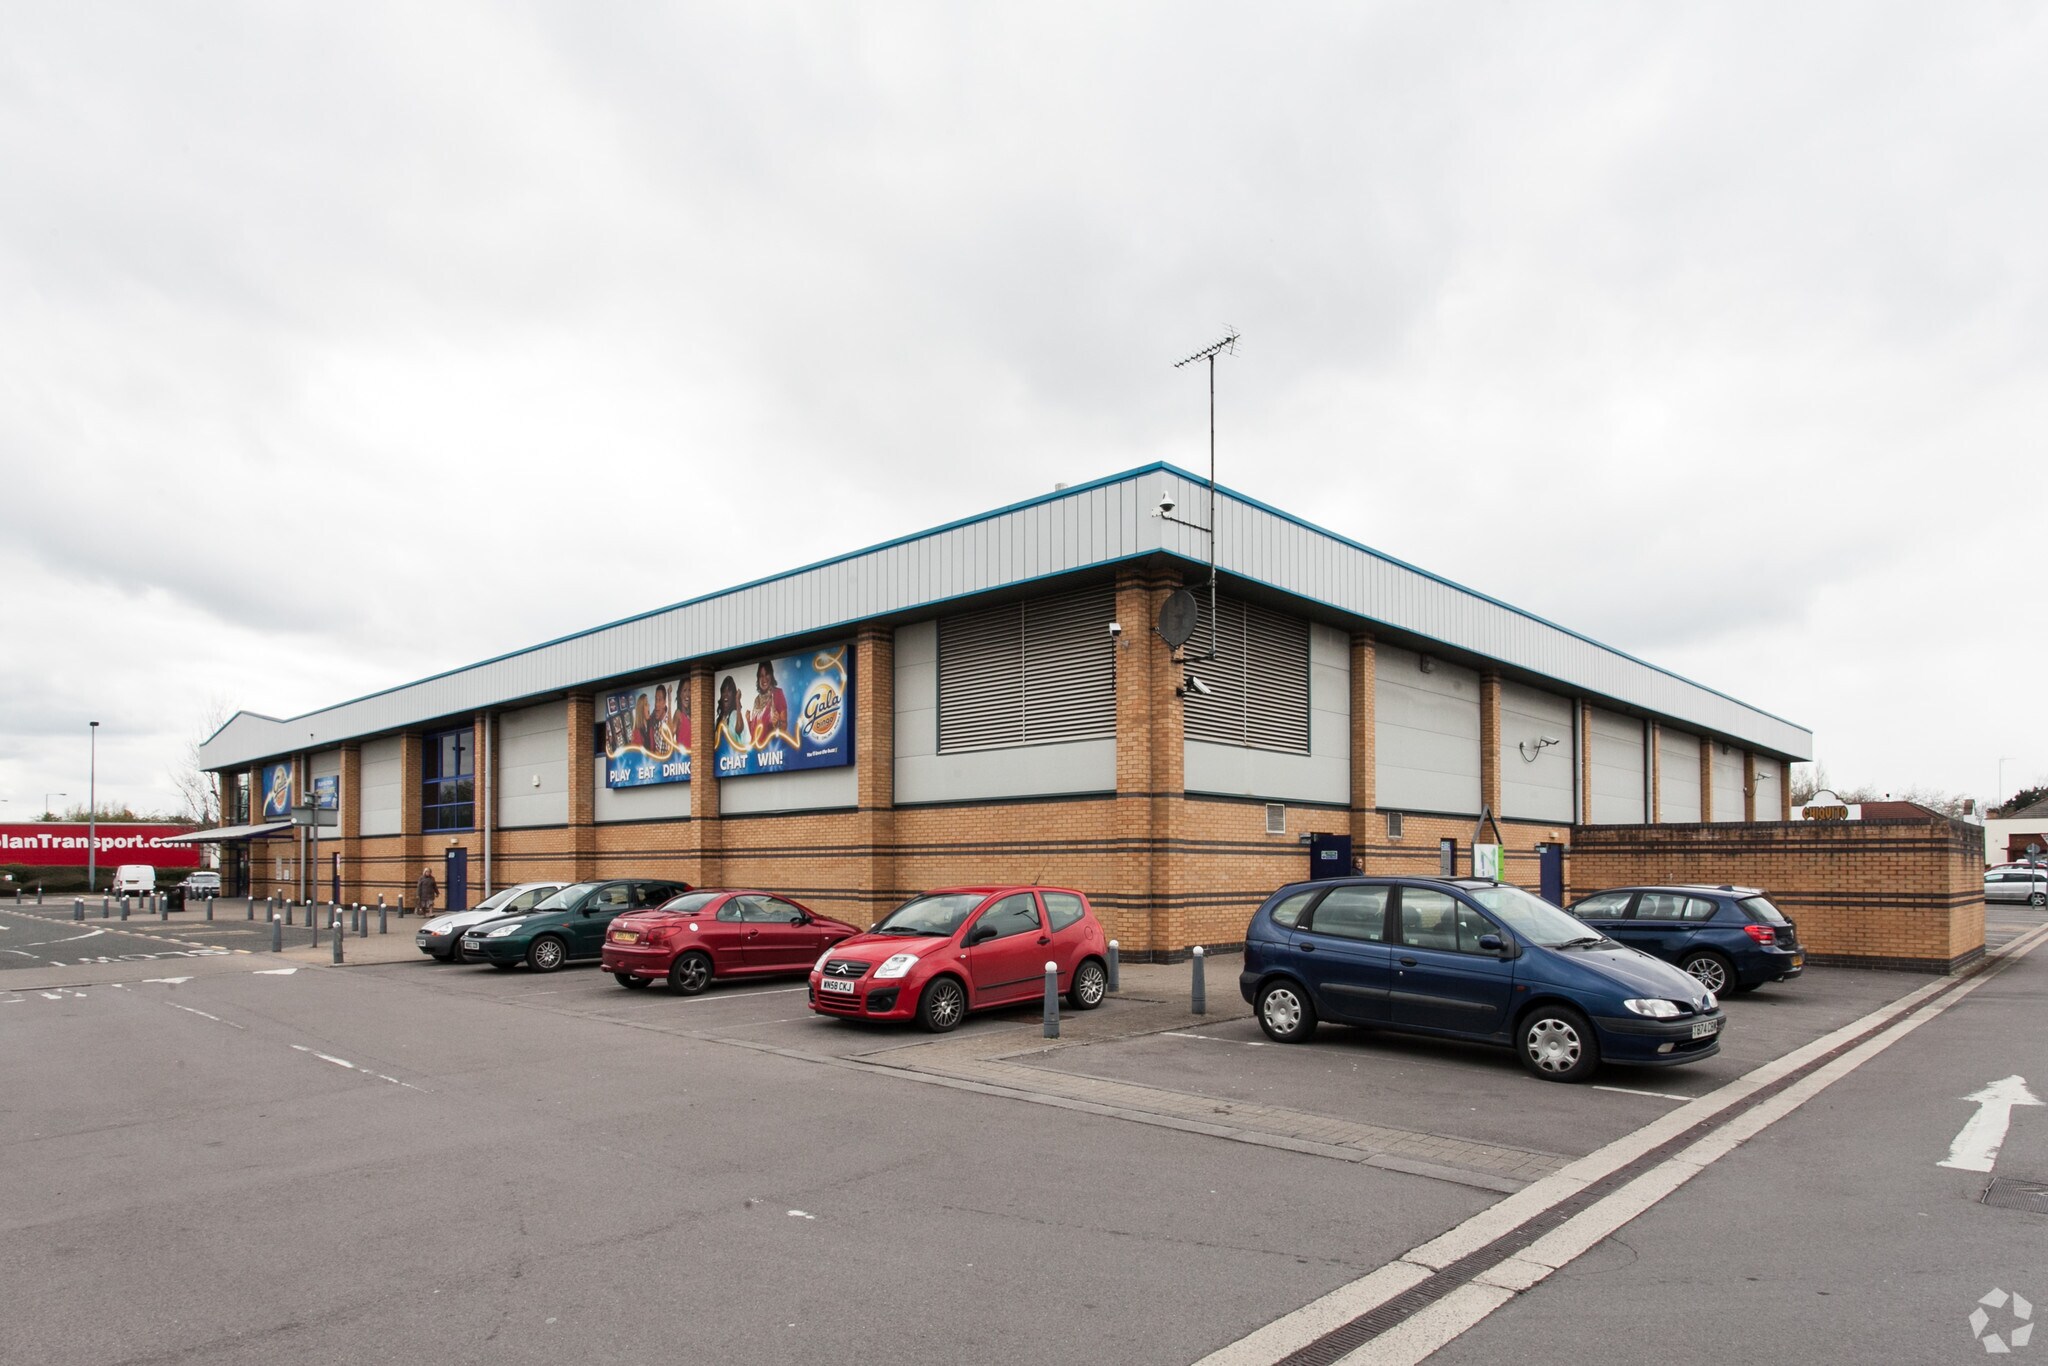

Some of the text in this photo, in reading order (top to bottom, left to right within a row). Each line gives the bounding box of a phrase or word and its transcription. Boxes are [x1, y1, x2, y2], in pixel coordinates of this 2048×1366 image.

[803, 690, 842, 735] Gala
[719, 750, 784, 771] CHAT WIN!
[609, 762, 691, 783] PLAY EAT DRINK
[1802, 805, 1848, 820] CHIQUITO
[839, 982, 851, 991] CKJ
